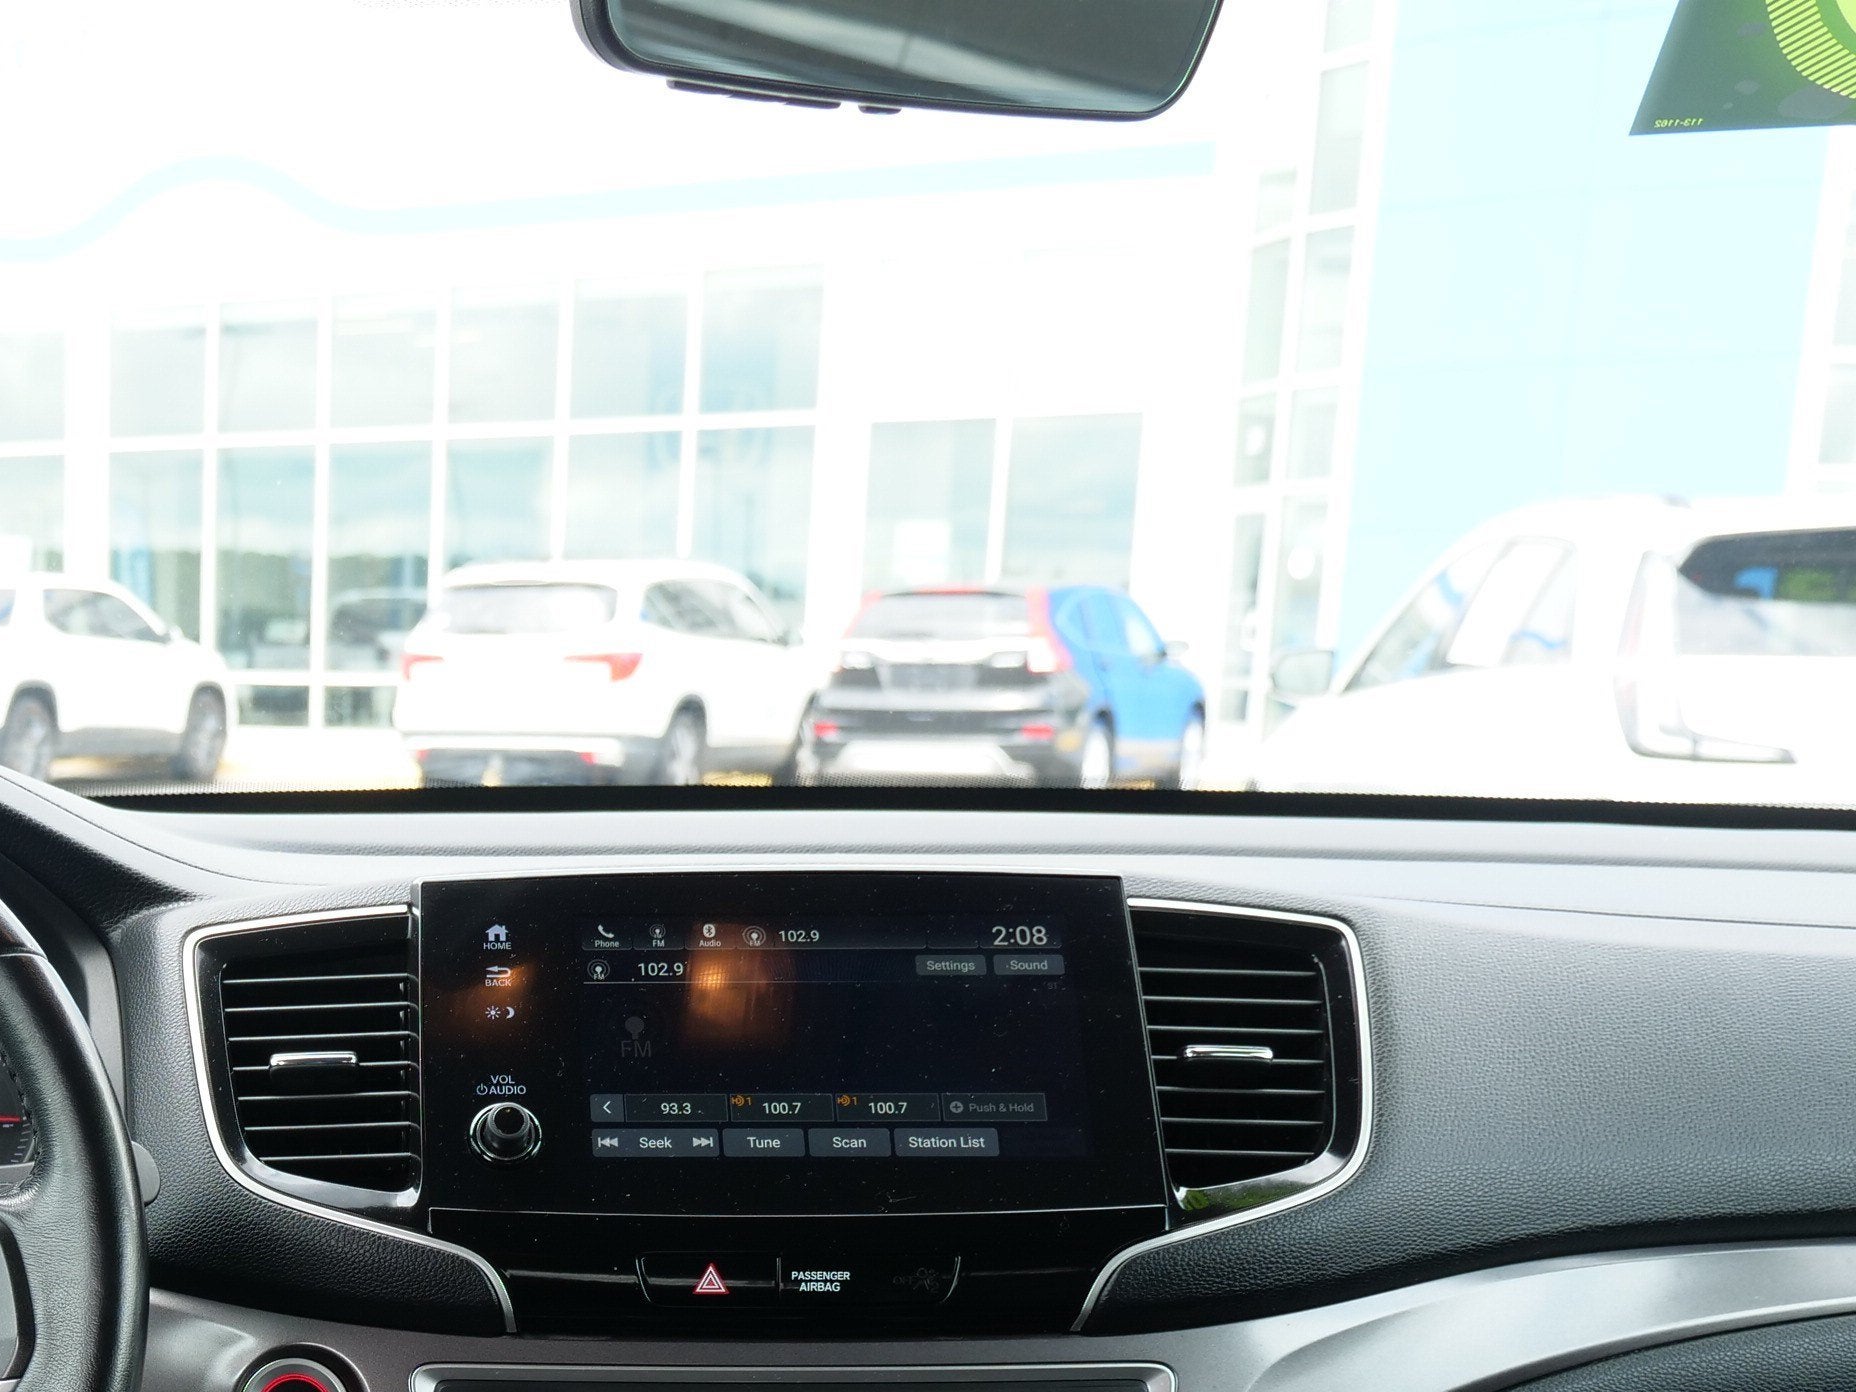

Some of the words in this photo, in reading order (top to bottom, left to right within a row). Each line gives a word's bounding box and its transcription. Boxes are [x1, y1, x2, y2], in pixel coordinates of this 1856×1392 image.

[778, 930, 820, 942] 102.9
[991, 926, 1048, 946] 2:08
[483, 942, 512, 950] HOME
[594, 940, 620, 949] Phone
[652, 939, 665, 948] FM
[699, 939, 722, 948] Audio
[637, 963, 684, 977] 102.9
[926, 960, 977, 973] Settings
[1010, 960, 1048, 971] Sound
[485, 979, 512, 987] BACK
[621, 1040, 652, 1058] FM
[490, 1075, 516, 1084] VOL
[489, 1085, 527, 1095] AUDIO
[660, 1102, 692, 1115] 93.3
[762, 1101, 802, 1115] 100.7
[868, 1101, 908, 1115] 100.7
[969, 1102, 996, 1113] Push
[997, 1102, 1005, 1112] &
[1008, 1102, 1035, 1112] Hold
[638, 1136, 673, 1149] Seek
[747, 1136, 781, 1149] Tune
[832, 1136, 867, 1149] Scan
[908, 1136, 958, 1149] Station
[960, 1136, 986, 1149] List
[791, 1271, 851, 1281] PASSENGER
[799, 1282, 841, 1293] AIRBAG
